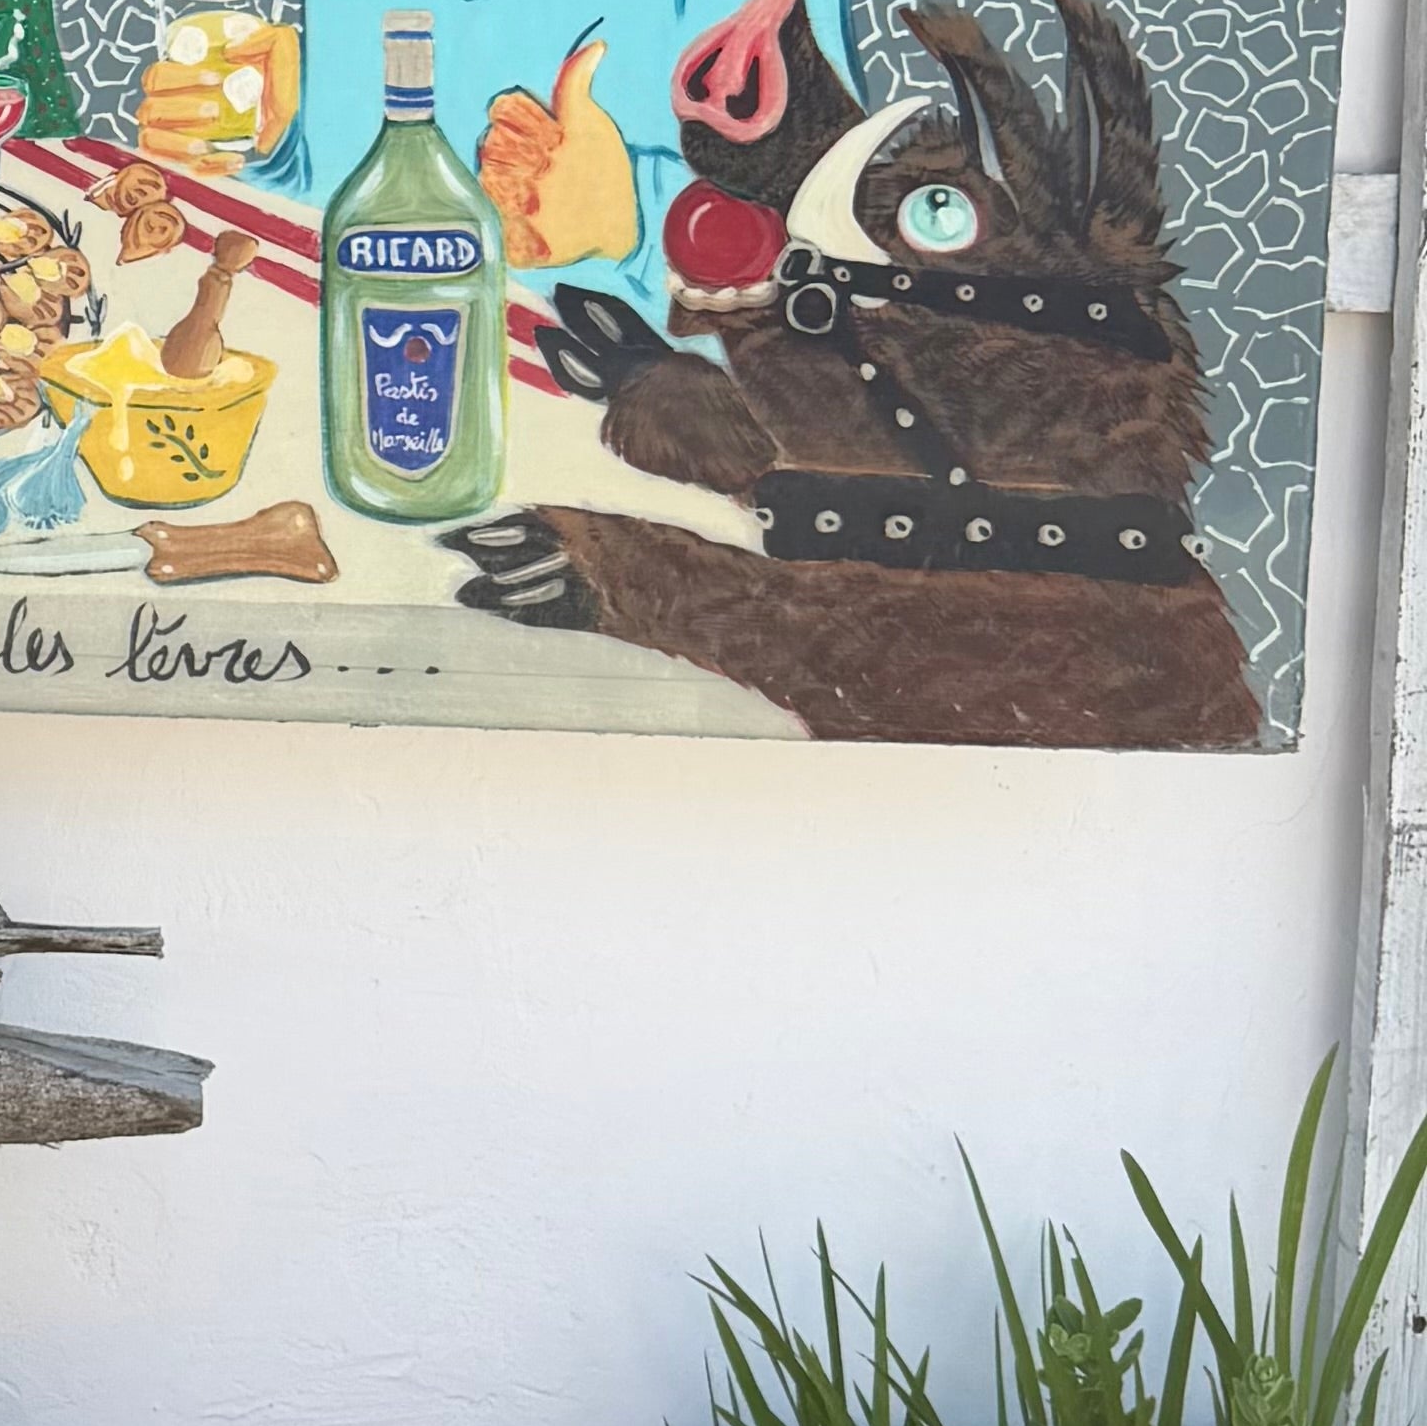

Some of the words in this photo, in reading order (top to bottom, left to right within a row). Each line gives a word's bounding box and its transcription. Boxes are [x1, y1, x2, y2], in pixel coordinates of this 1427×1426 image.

[349, 235, 476, 268] RICARD
[375, 371, 439, 402] Pastis
[395, 406, 420, 427] de
